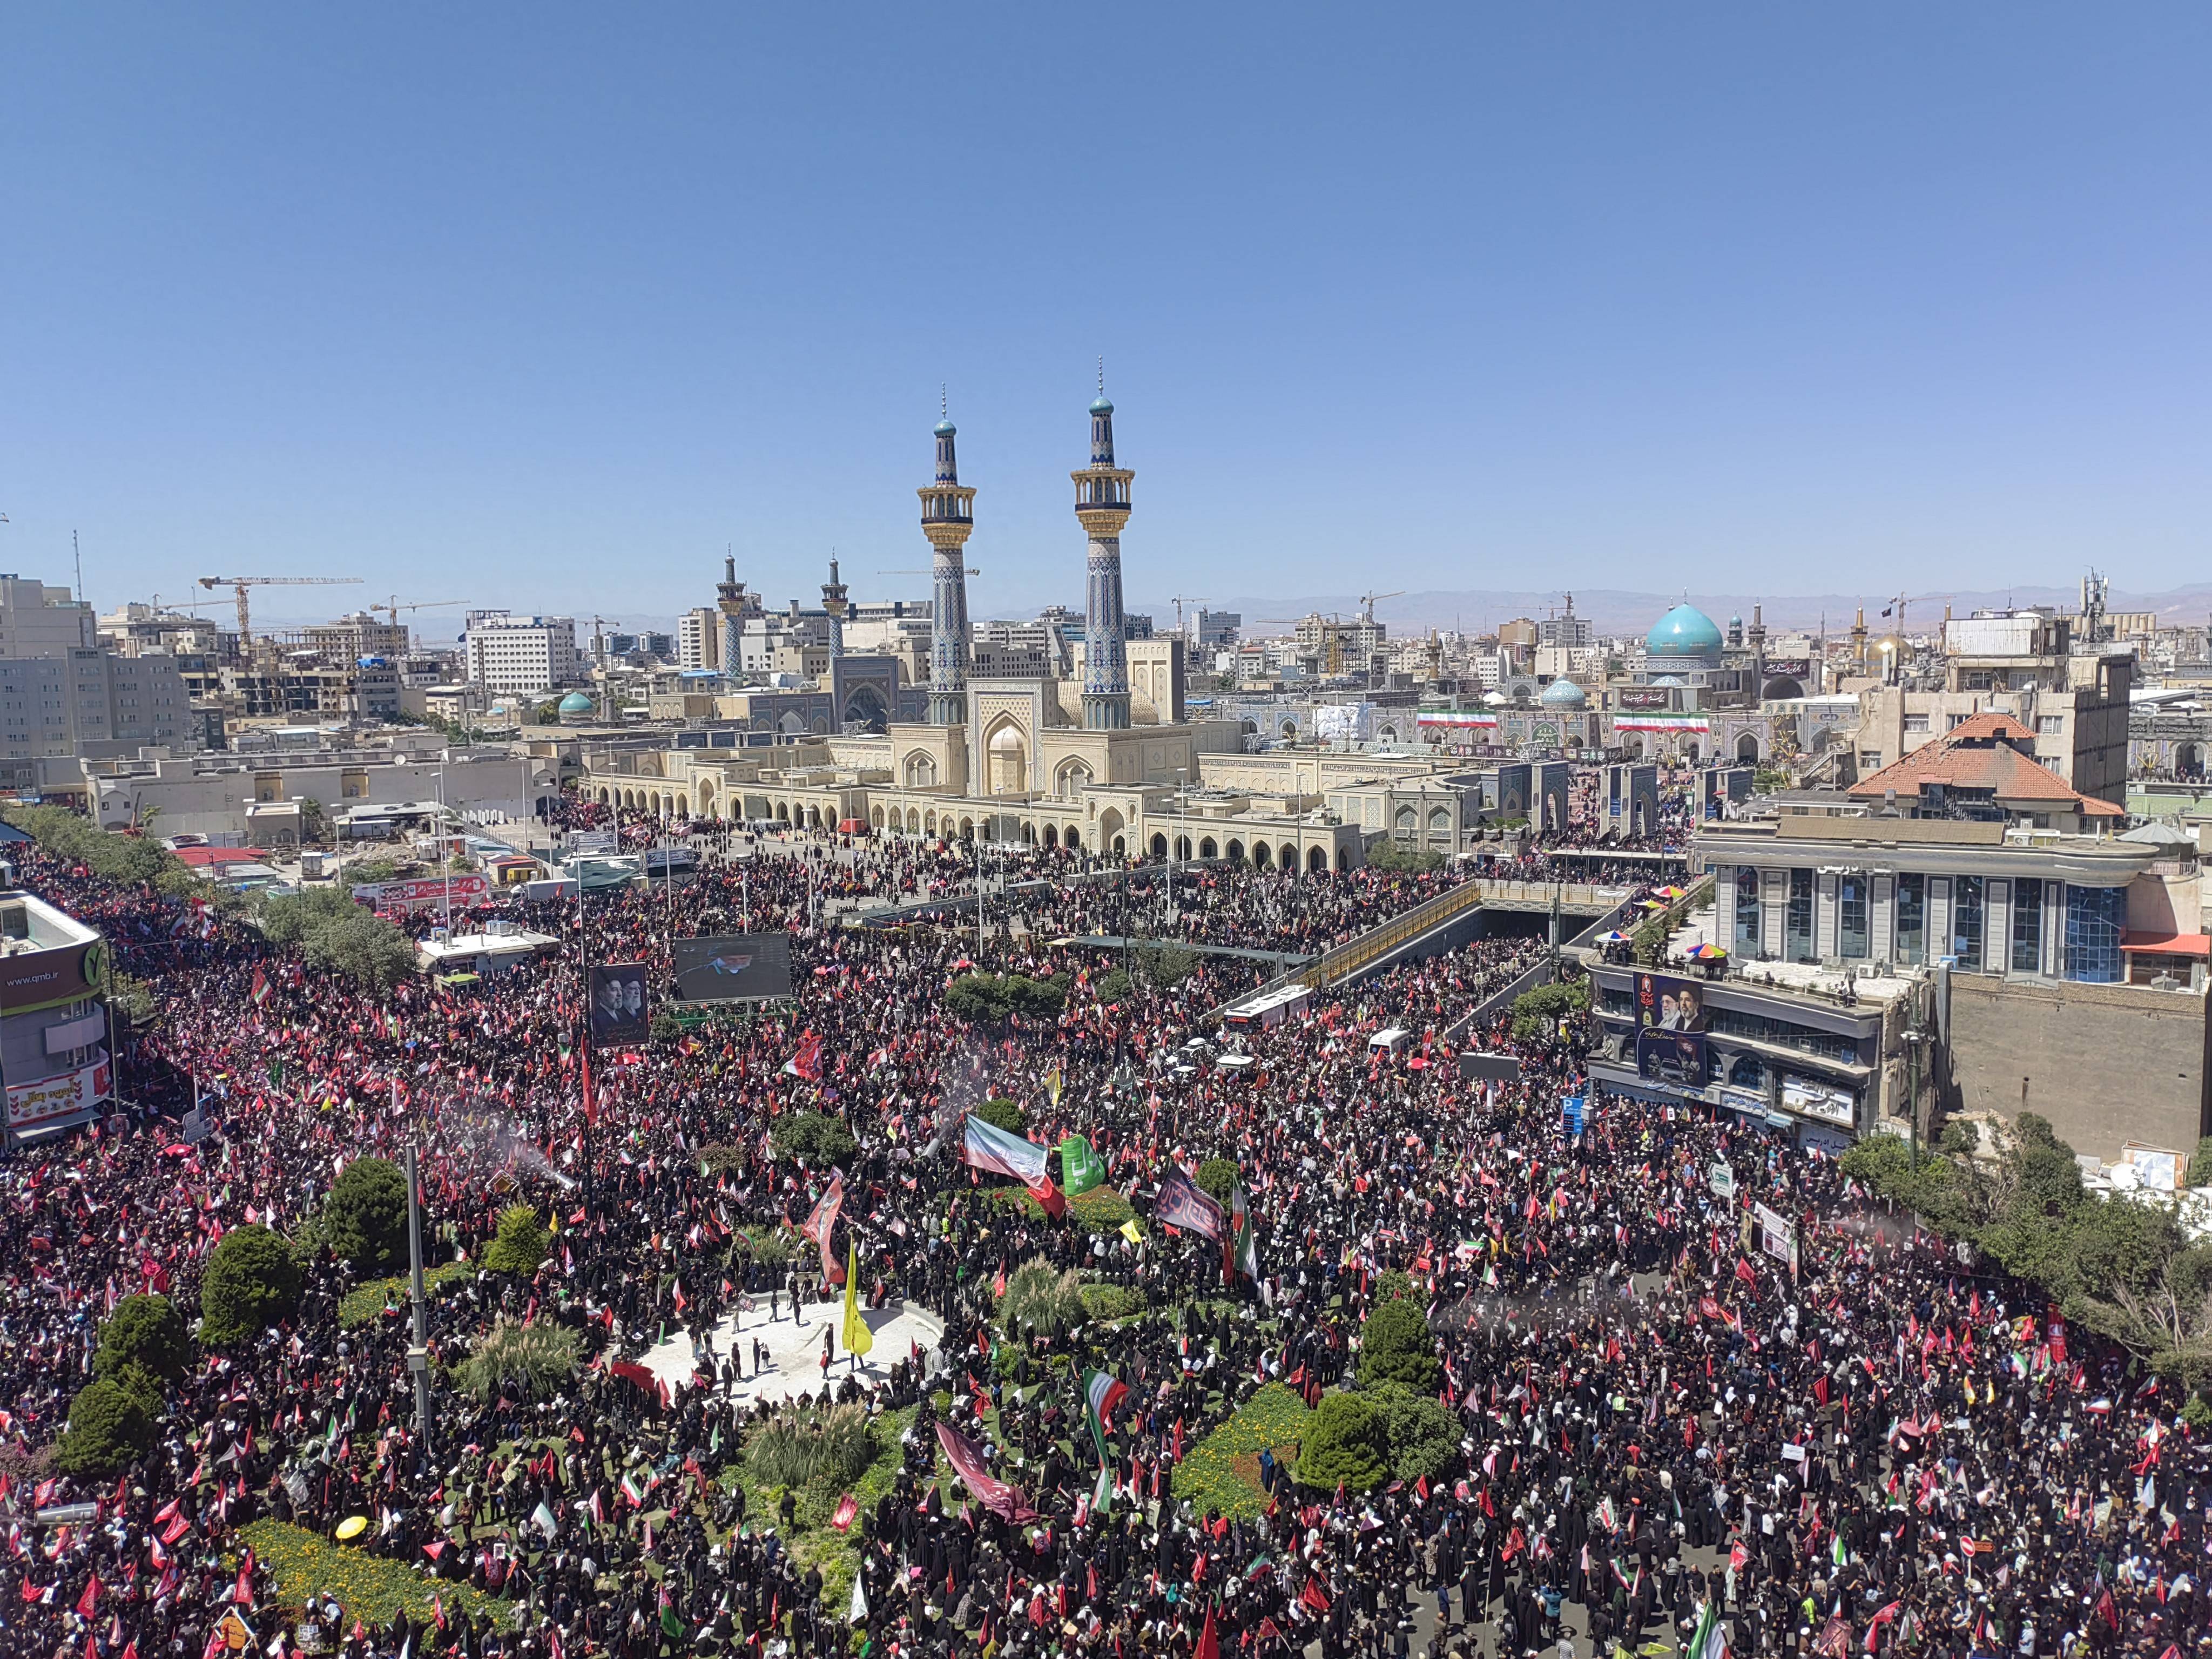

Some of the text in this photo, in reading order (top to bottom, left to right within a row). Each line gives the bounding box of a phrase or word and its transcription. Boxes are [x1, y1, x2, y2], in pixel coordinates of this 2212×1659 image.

[6, 972, 59, 987] www.qmb.ir
[20, 1077, 76, 1108] آبمیوه بستنی
[1563, 1099, 1573, 1110] P
[1806, 1136, 1830, 1146] ادریس
